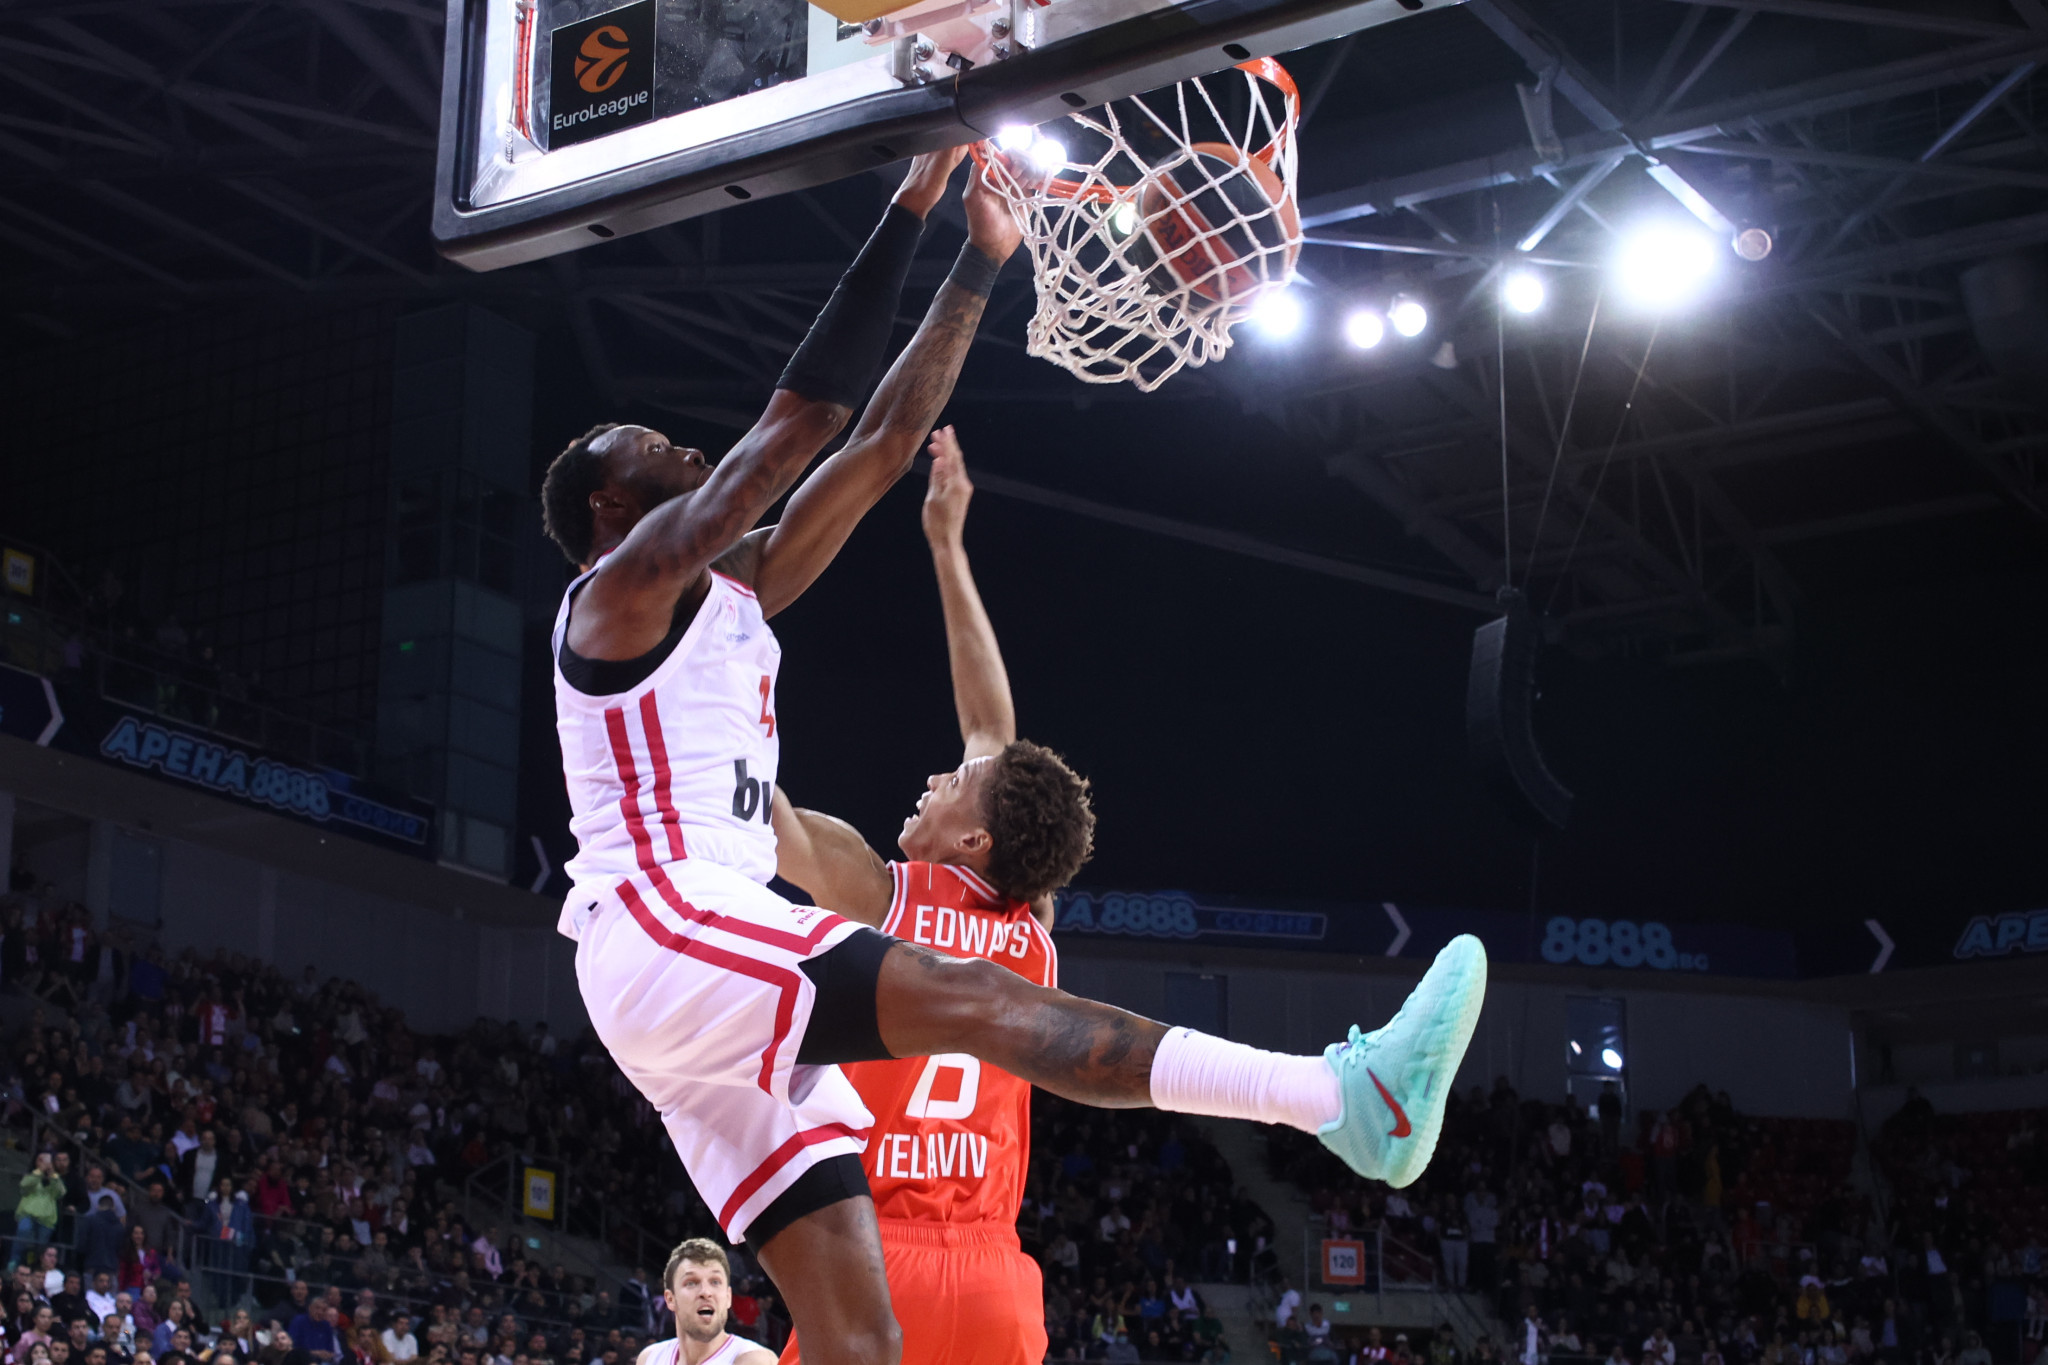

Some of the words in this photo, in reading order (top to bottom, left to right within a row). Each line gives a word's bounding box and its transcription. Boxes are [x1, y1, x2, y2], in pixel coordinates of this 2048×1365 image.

[553, 90, 648, 130] EuroLeague
[251, 762, 331, 815] 8888
[1100, 897, 1198, 933] 8888
[1333, 1255, 1356, 1269] 120
